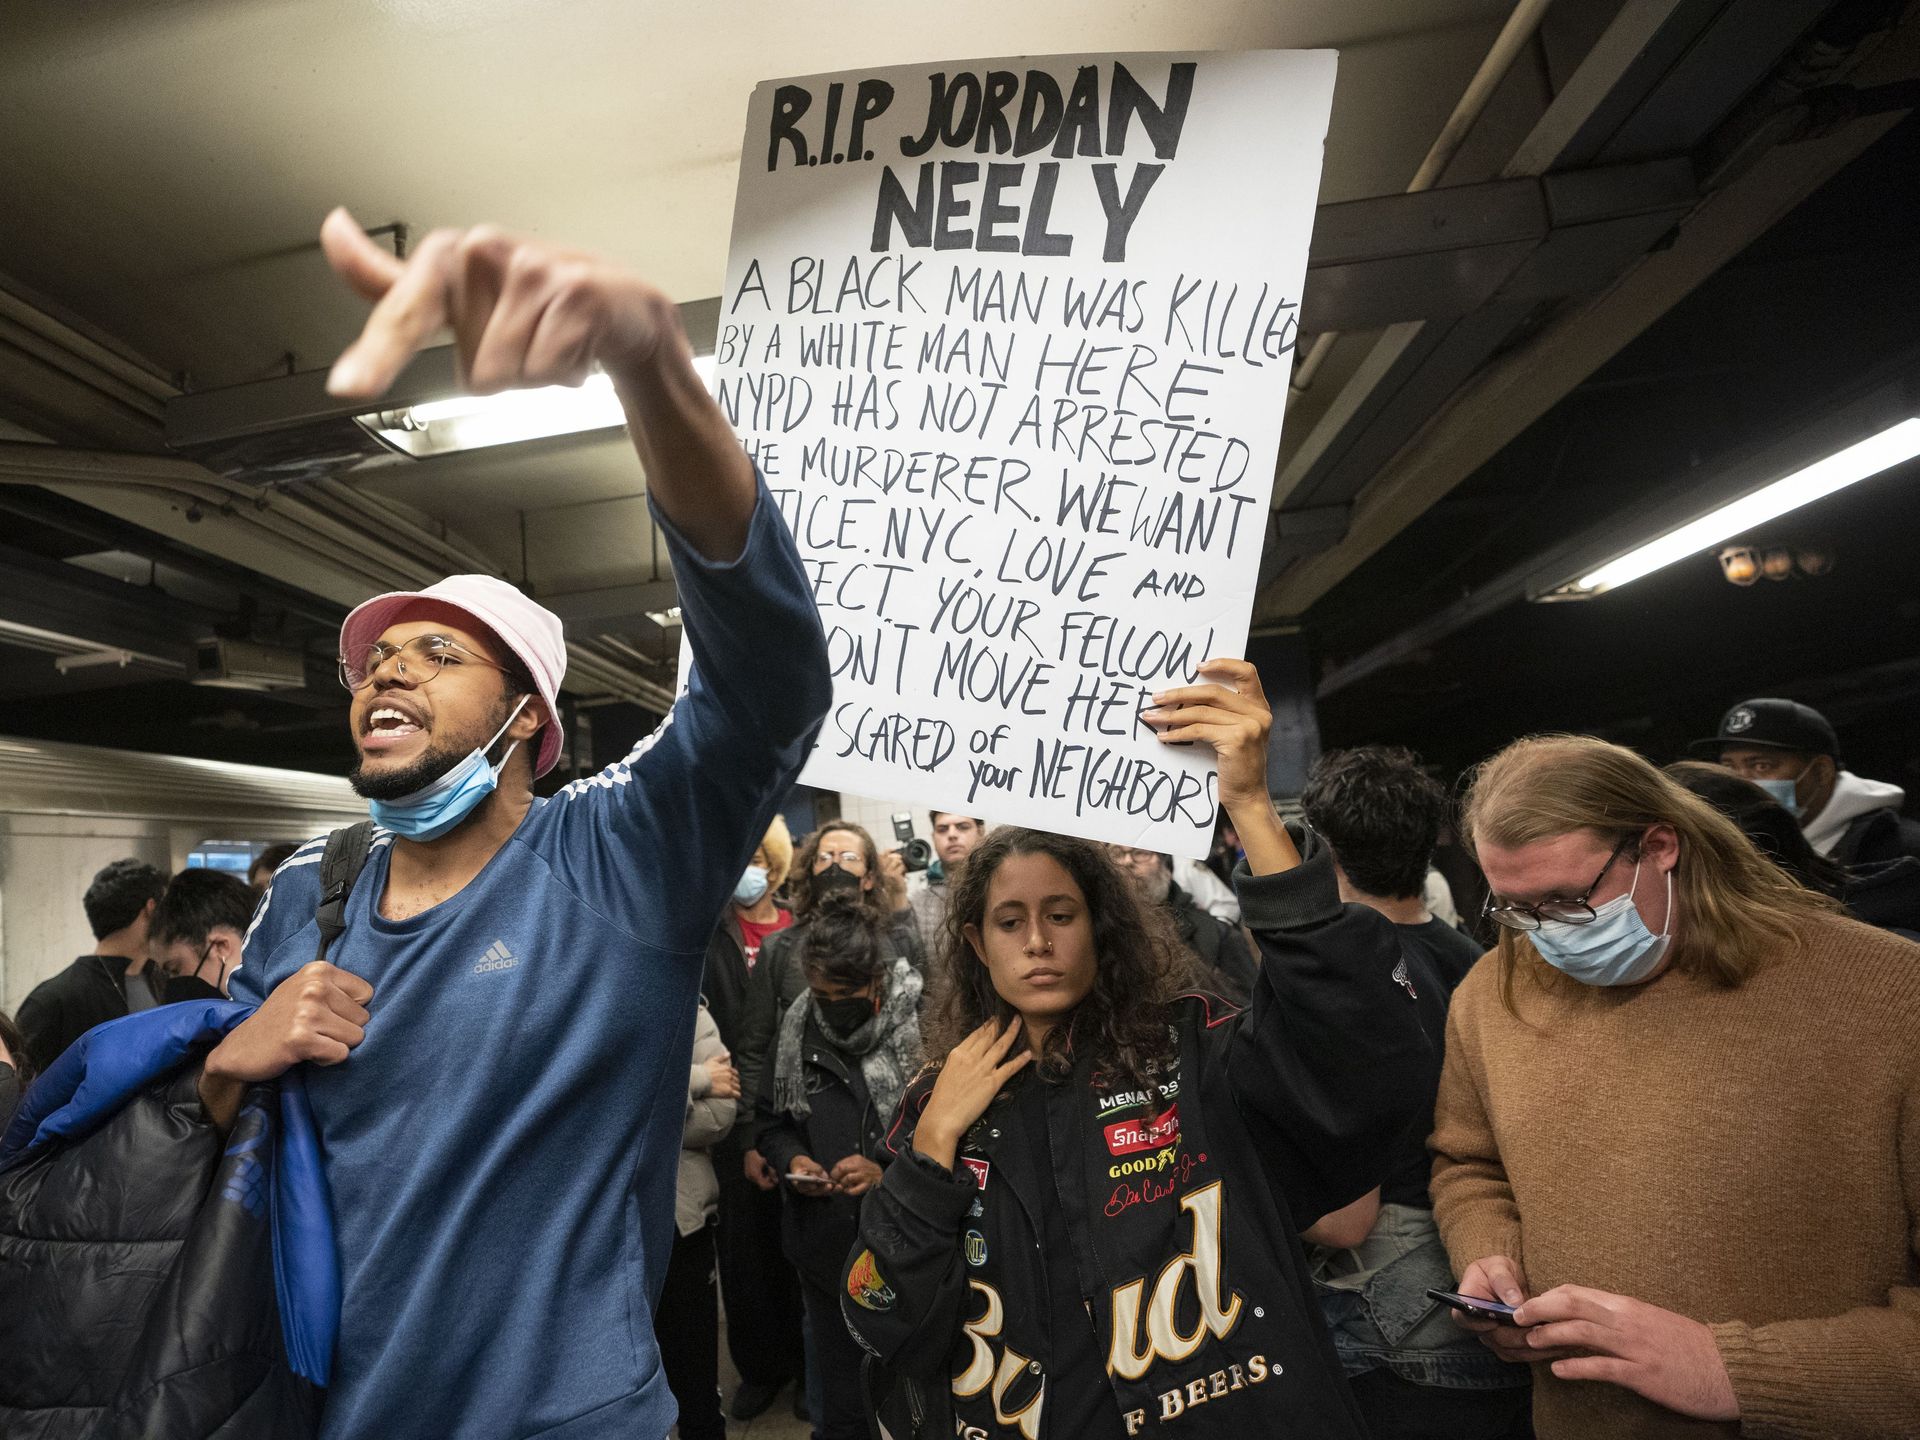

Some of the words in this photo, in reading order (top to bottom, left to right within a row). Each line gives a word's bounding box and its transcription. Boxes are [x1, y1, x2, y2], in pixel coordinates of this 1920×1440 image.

[767, 79, 895, 171] R.I.P.
[900, 61, 1198, 160] JORDAN
[870, 160, 1166, 263] NEELY
[731, 258, 771, 315] A
[787, 254, 927, 315] BLACK
[945, 265, 1048, 325] MAN
[1063, 277, 1147, 333] WAS
[1165, 273, 1298, 367] KILLED
[718, 324, 755, 367] BY
[764, 324, 781, 363] A
[800, 321, 908, 373] WHITE
[917, 323, 1015, 382] MAN
[1035, 333, 1224, 425] HERE.
[718, 372, 812, 433] NYPD
[832, 374, 902, 432] HAS
[918, 382, 1008, 441] NOT
[1009, 394, 1250, 493] ARRESTED
[737, 438, 780, 475] HE
[801, 437, 1041, 522] MURDERER.
[770, 488, 870, 554] TICE.
[998, 528, 1128, 602] LOVE
[1133, 568, 1206, 602] AND
[930, 577, 1044, 659] YOUR
[1059, 611, 1215, 685] FELLOW
[933, 637, 1056, 715] MOVE
[835, 702, 956, 773] SCARED
[967, 760, 1023, 803] your
[969, 724, 1011, 755] of
[1028, 737, 1218, 829] NEIGHBORS
[473, 957, 519, 975] adidas
[1108, 1144, 1179, 1178] GOODY
[1122, 1408, 1146, 1436] F
